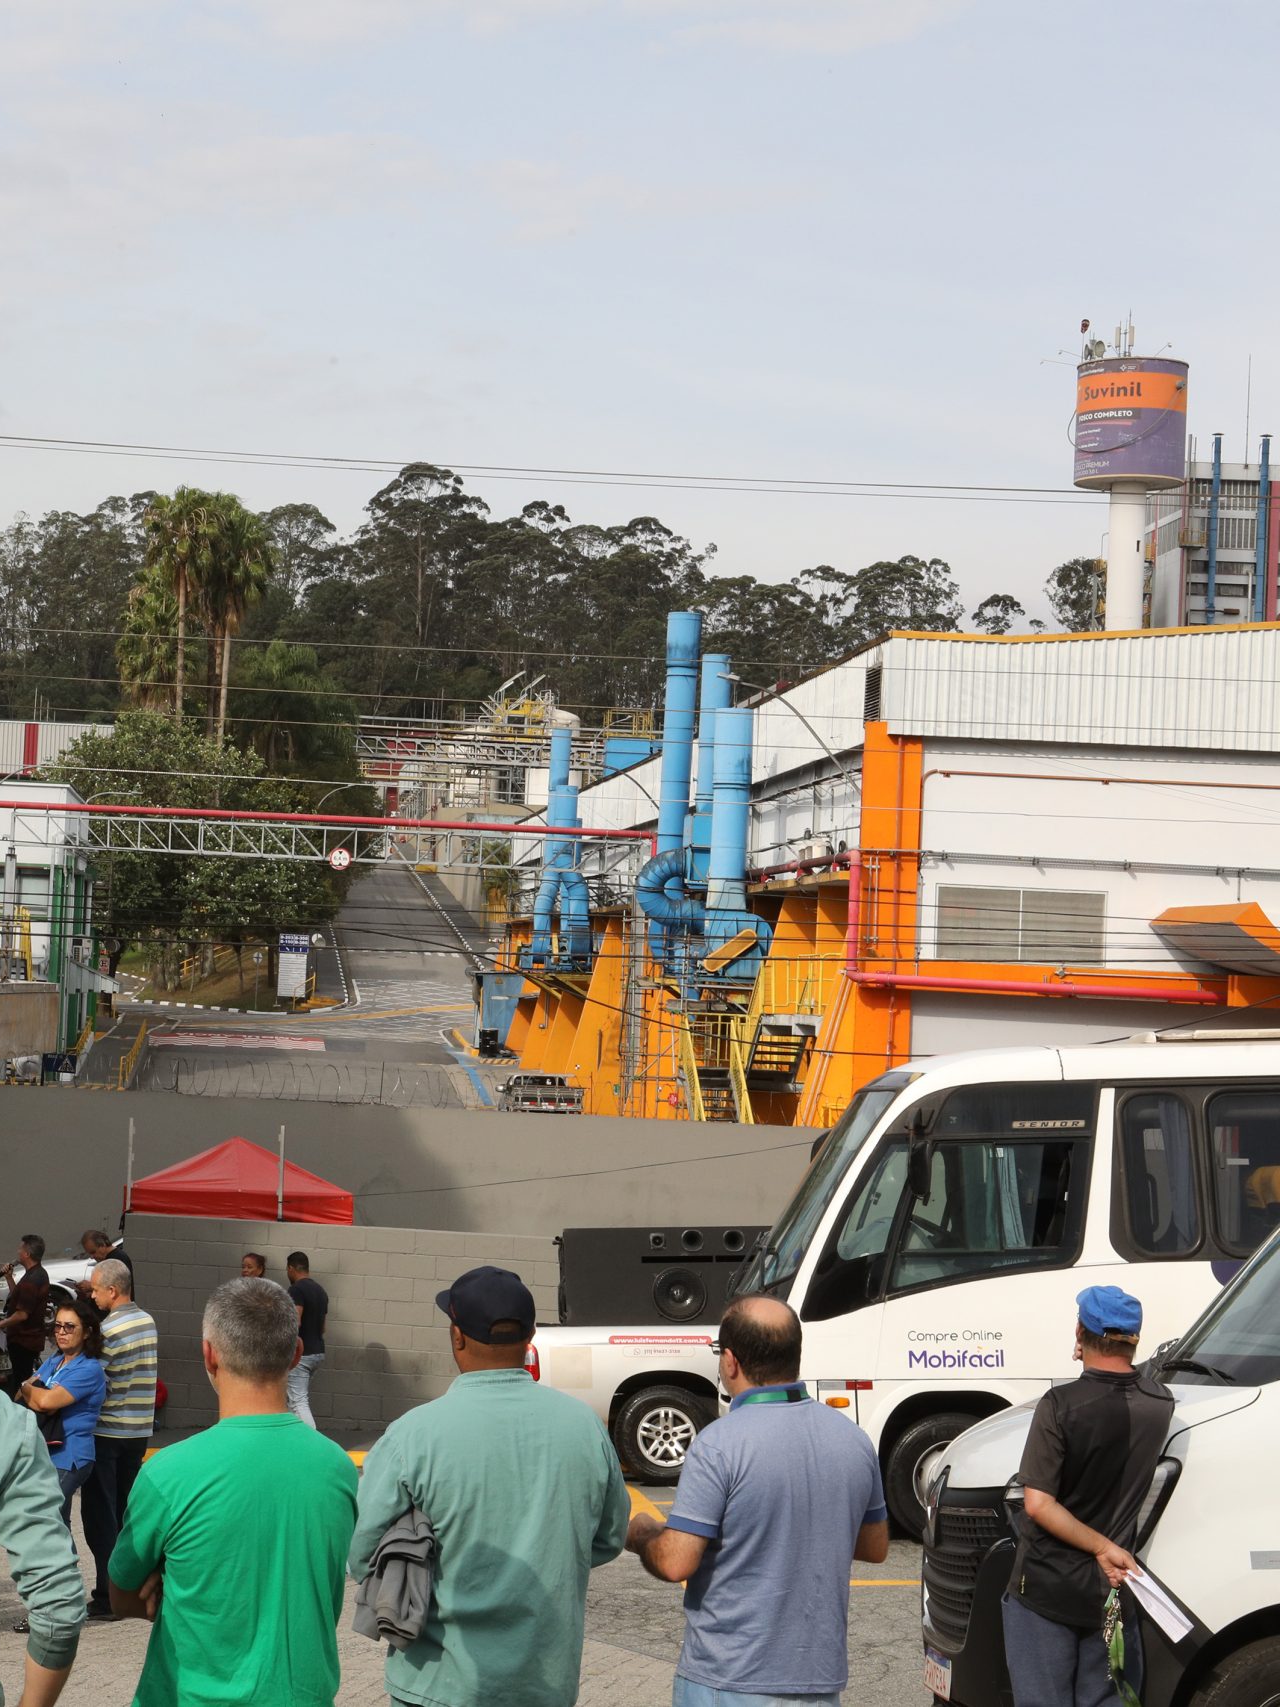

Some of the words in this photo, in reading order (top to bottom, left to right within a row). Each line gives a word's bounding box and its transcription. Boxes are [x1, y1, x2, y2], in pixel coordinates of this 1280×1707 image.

[1084, 382, 1142, 400] Suvinil
[1094, 410, 1133, 419] COMPLETO
[907, 1330, 959, 1344] Compre
[962, 1329, 1003, 1341] Online
